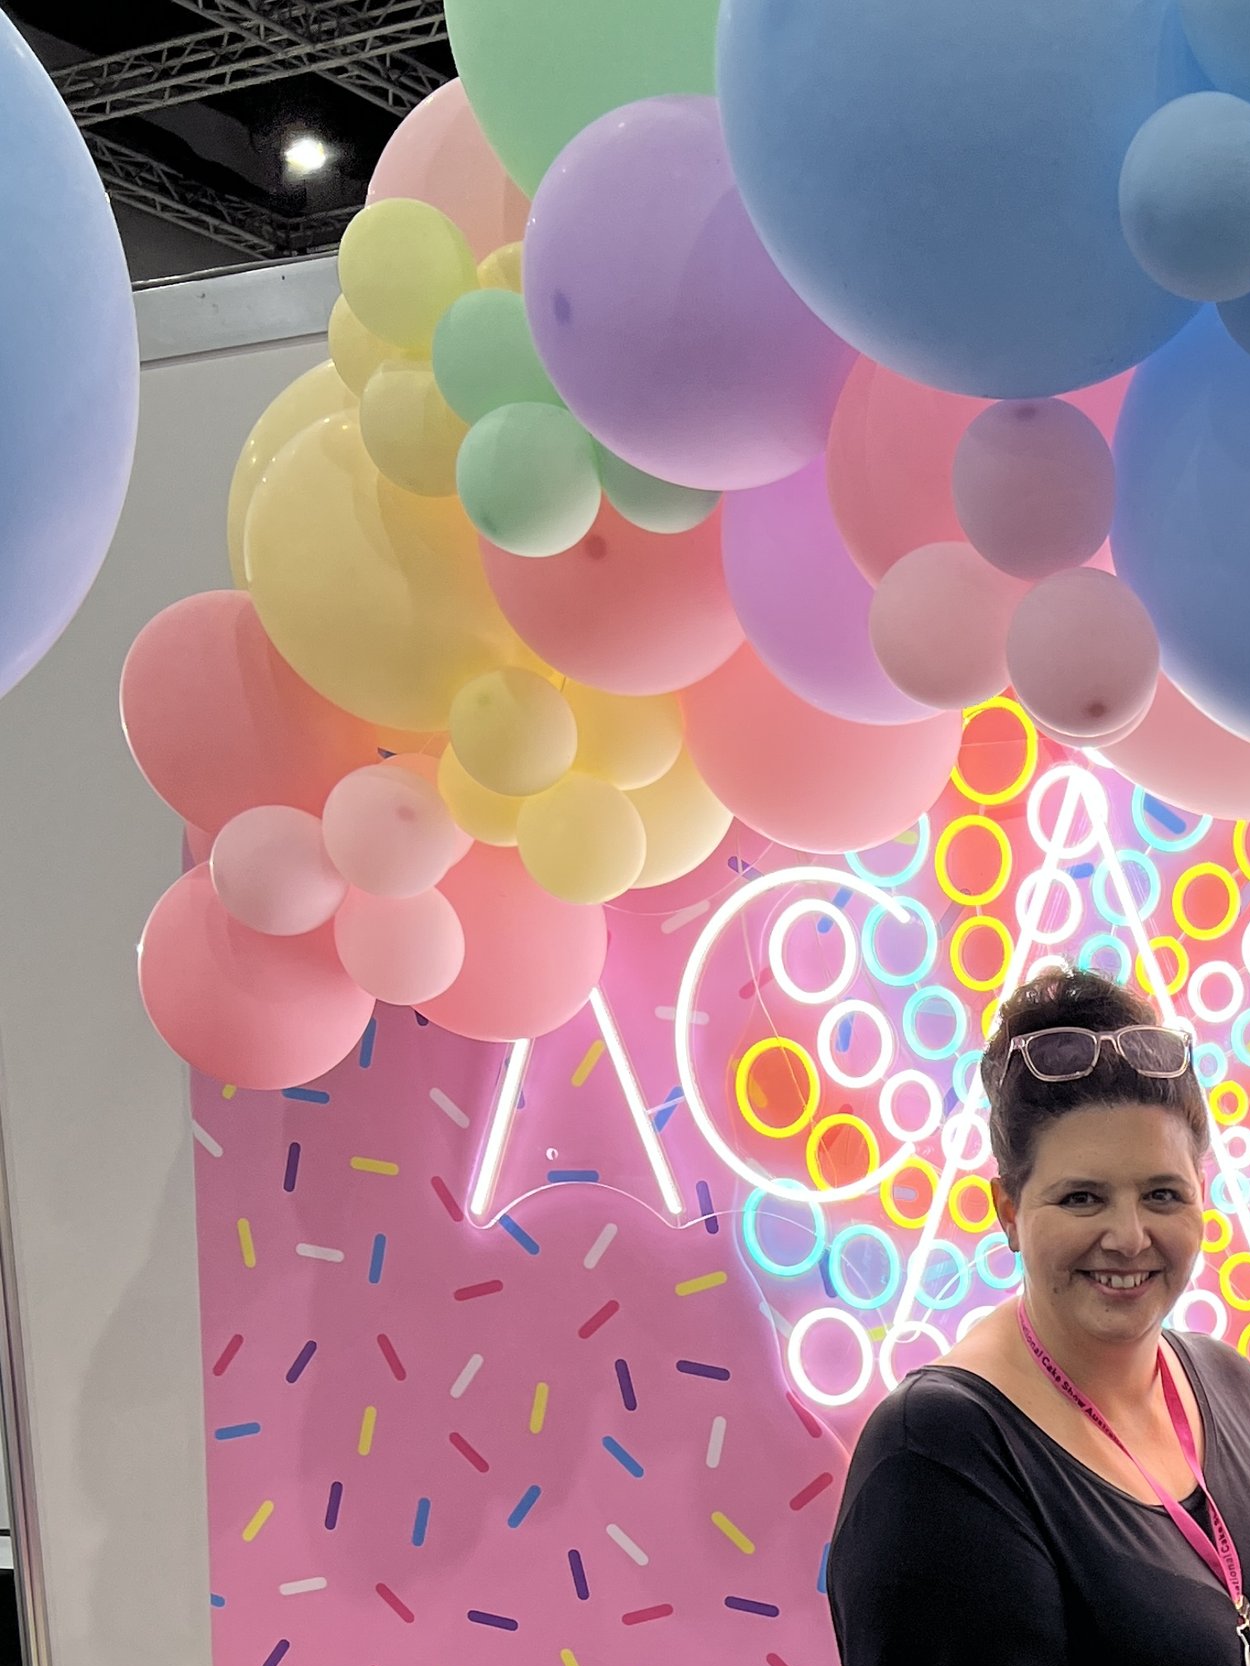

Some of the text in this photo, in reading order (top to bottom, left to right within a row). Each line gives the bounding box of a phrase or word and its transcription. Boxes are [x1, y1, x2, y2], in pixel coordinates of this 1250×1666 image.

[1041, 1356, 1062, 1383] Cake
[1061, 1381, 1087, 1409] Show
[1217, 1526, 1230, 1554] Cake
